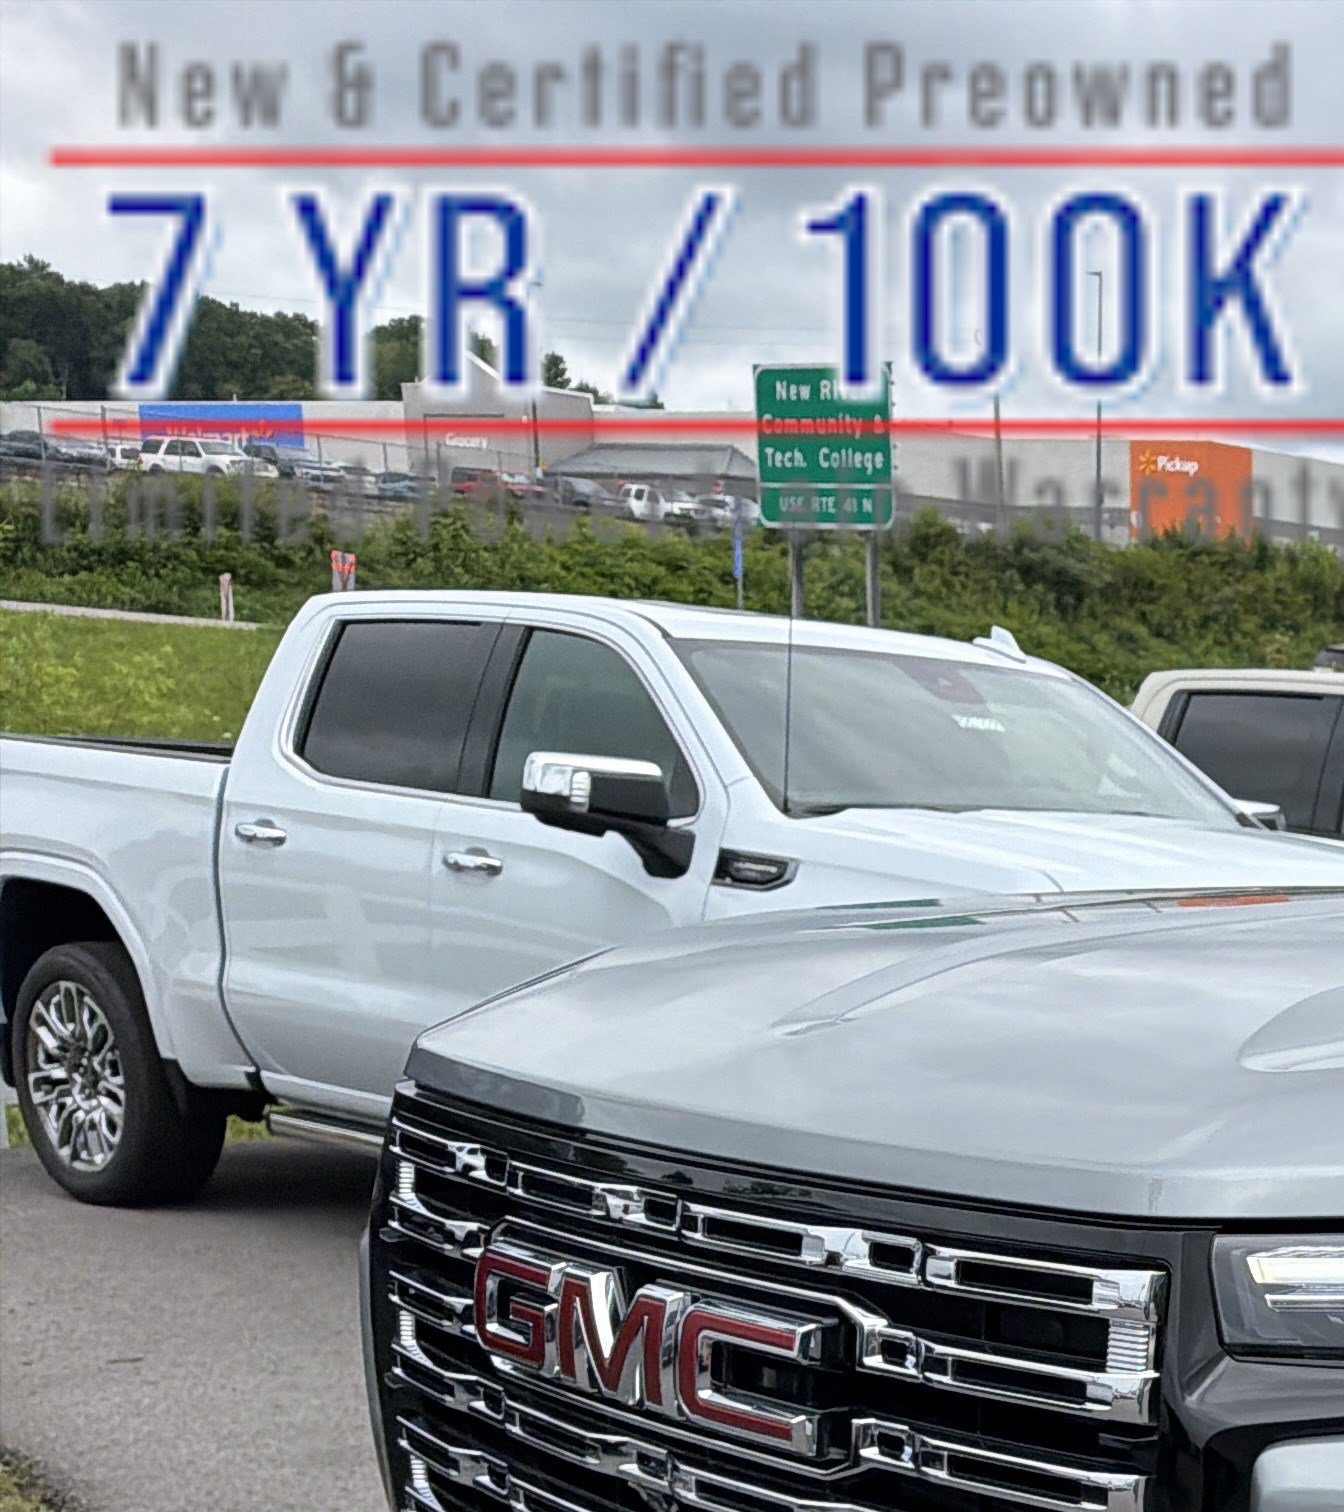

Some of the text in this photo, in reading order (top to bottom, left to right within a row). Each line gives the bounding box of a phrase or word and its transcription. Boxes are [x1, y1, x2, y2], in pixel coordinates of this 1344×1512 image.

[775, 379, 811, 401] New
[761, 413, 864, 440] Community
[764, 446, 885, 475] Tech. College
[1156, 454, 1199, 476] Pickup
[861, 496, 874, 514] N
[474, 1239, 824, 1457] GMC
